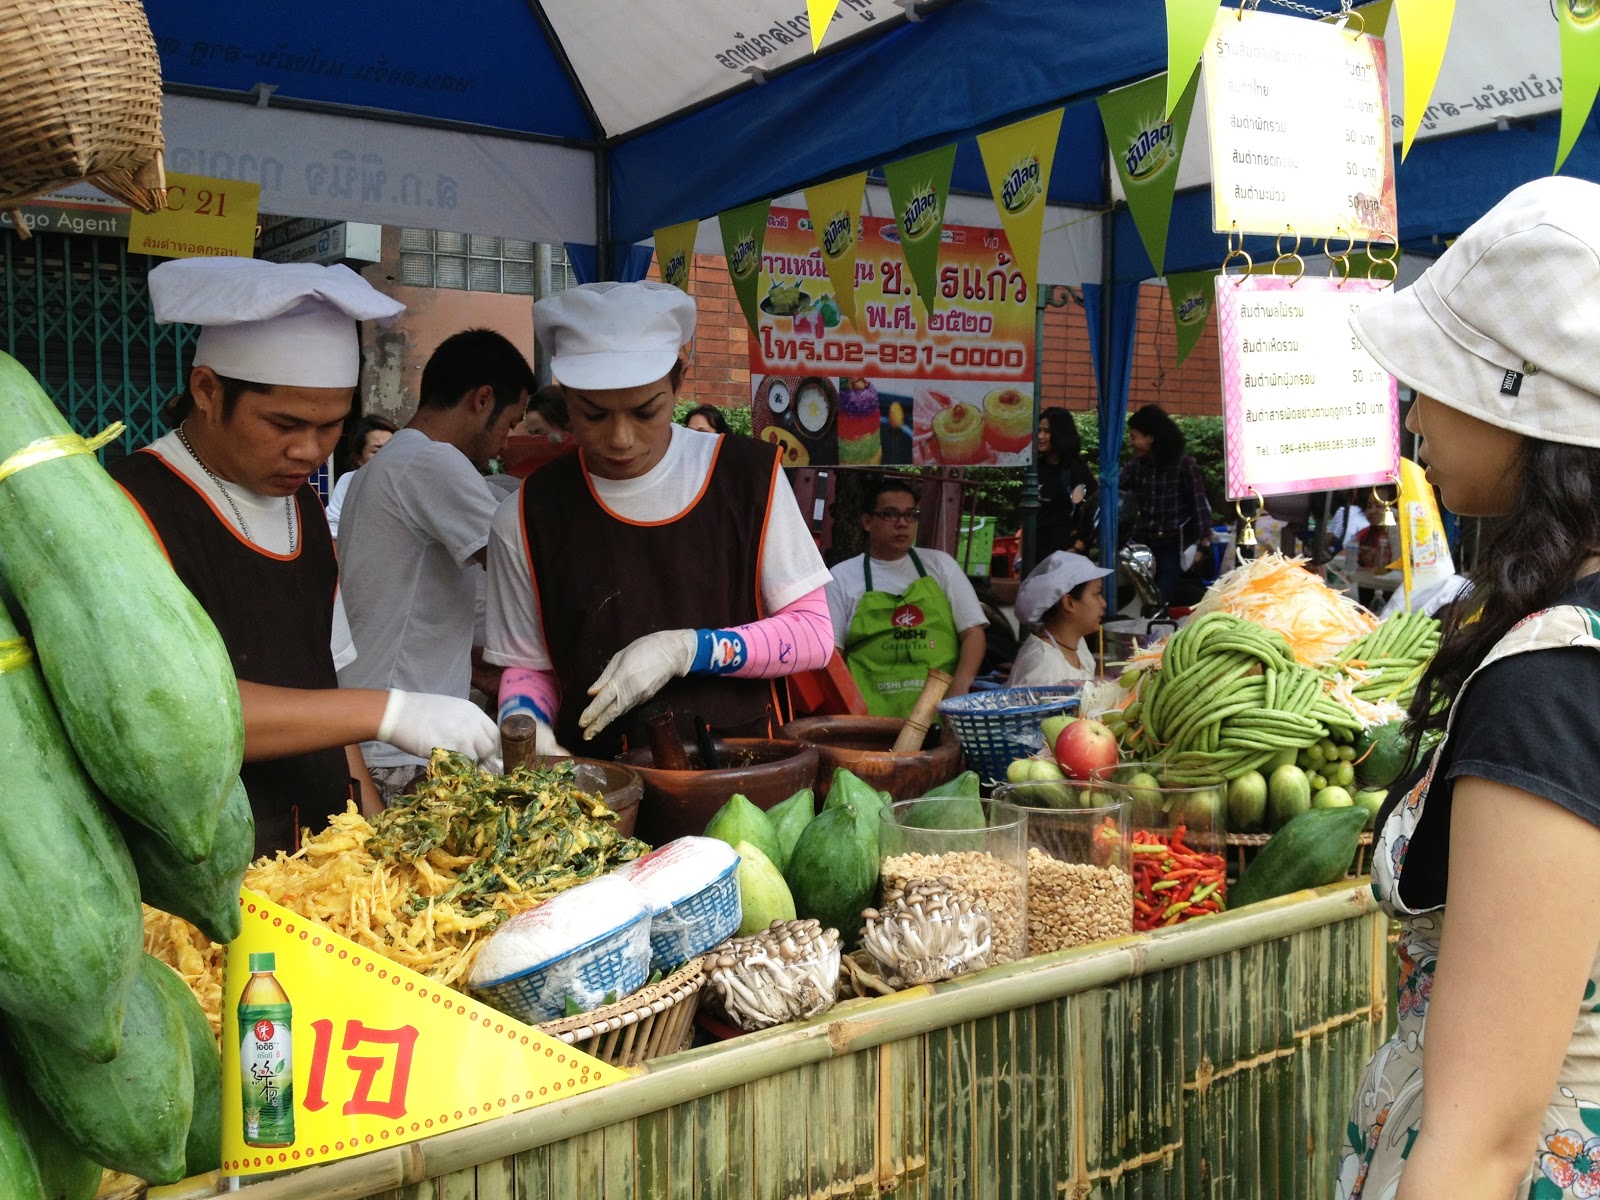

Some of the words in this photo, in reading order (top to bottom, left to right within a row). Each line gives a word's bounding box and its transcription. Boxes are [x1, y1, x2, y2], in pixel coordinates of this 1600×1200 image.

[1346, 162, 1358, 176] 50
[194, 190, 226, 217] 21
[57, 211, 117, 234] Agent
[880, 252, 1028, 303] ช.รแก้ว
[866, 304, 916, 330] พ.ศ.
[893, 629, 927, 640] OISHI
[877, 682, 901, 690] OISHI
[903, 679, 926, 688] GREE
[302, 1018, 420, 1120] เจ
